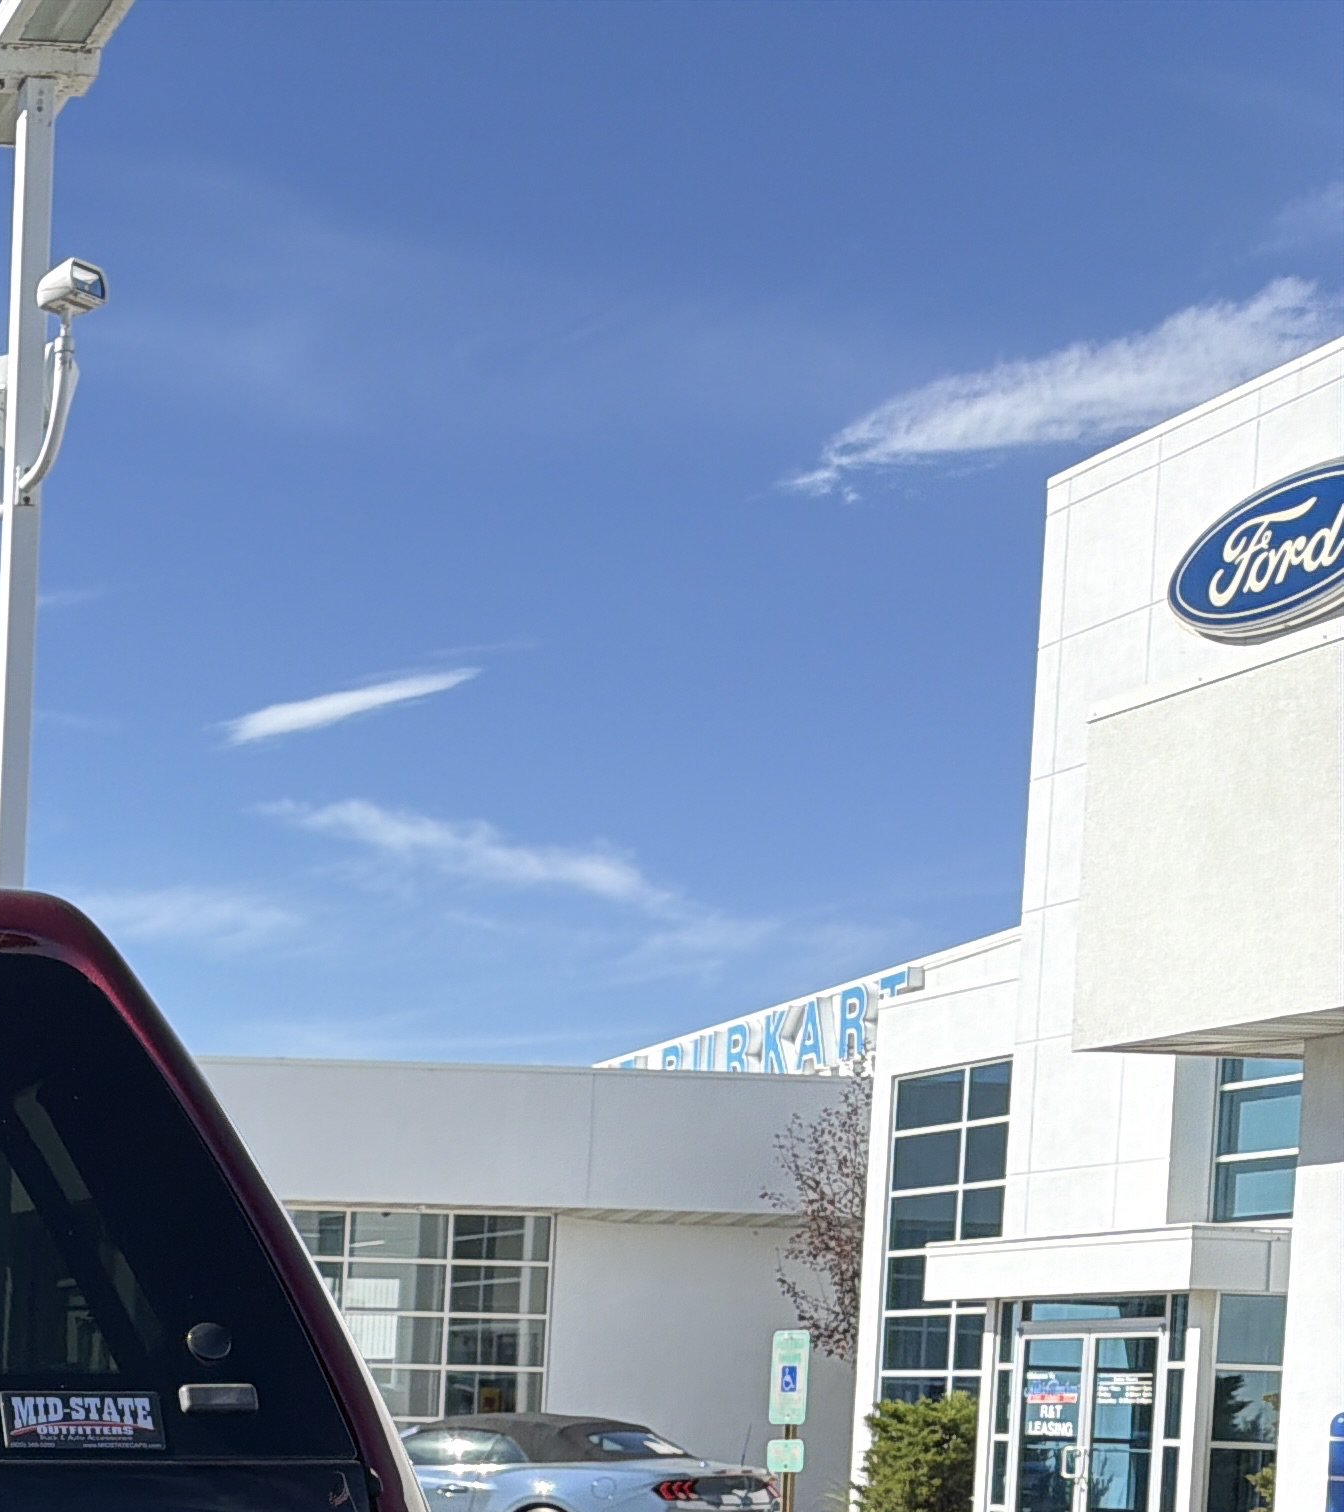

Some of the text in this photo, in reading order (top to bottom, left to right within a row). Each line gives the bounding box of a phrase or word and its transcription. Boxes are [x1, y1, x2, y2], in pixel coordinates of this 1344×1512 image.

[1208, 495, 1344, 608] Ford
[11, 1396, 155, 1431] MID-STATE
[1040, 1404, 1063, 1419] R&T
[37, 1425, 134, 1436] OUTFITTERS
[1027, 1420, 1073, 1438] LEASING
